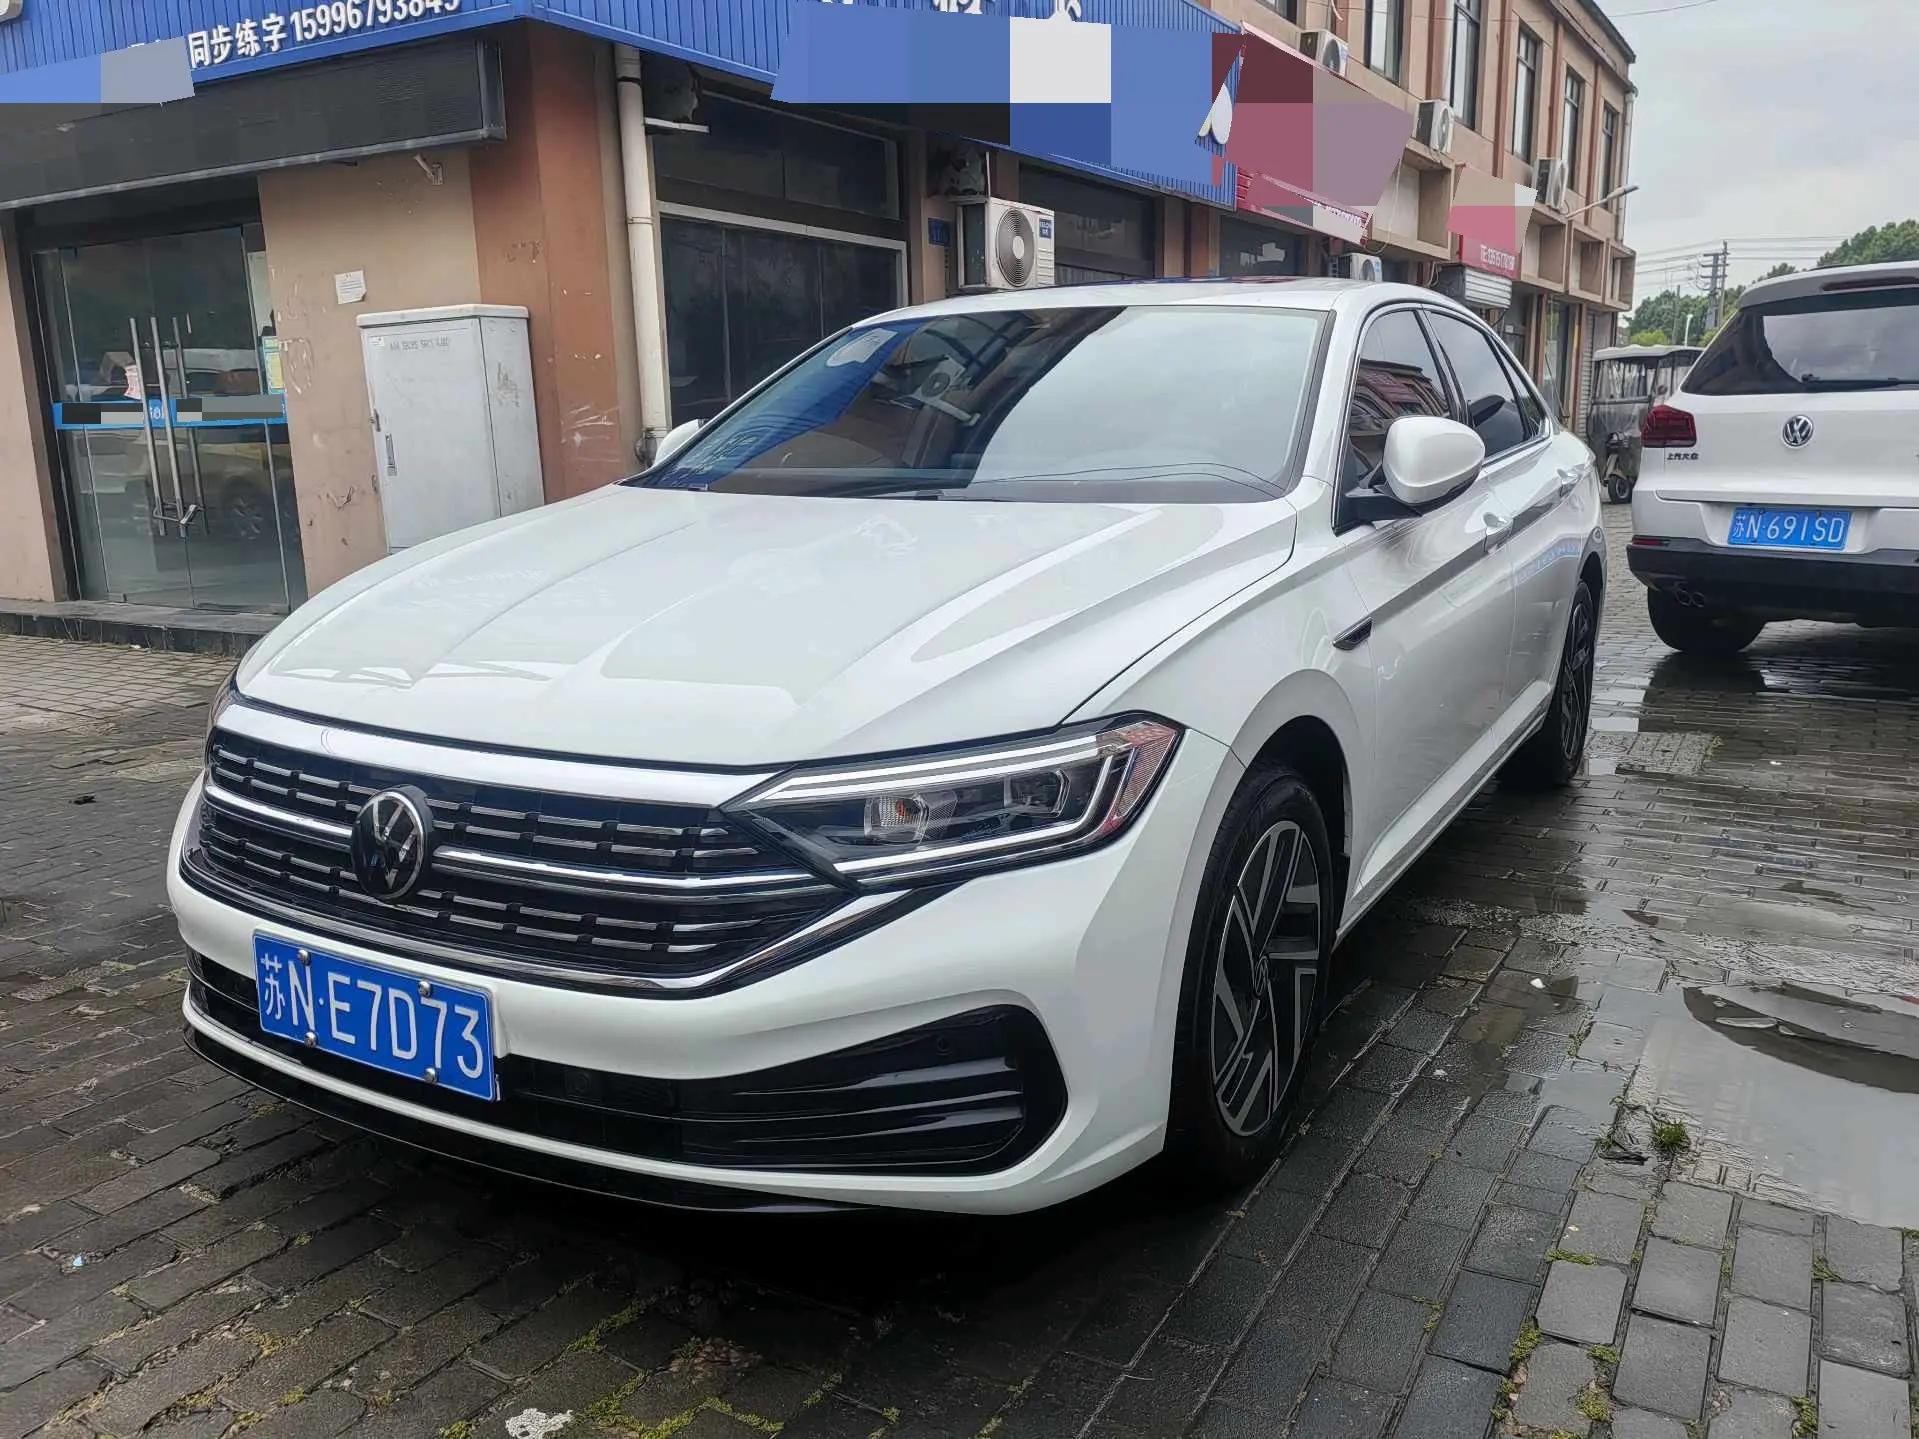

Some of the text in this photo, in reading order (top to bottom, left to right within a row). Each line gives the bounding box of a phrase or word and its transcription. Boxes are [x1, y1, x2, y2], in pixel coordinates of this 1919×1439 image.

[188, 13, 287, 69] 同步练字
[260, 951, 484, 1080] 苏N·E7D73
